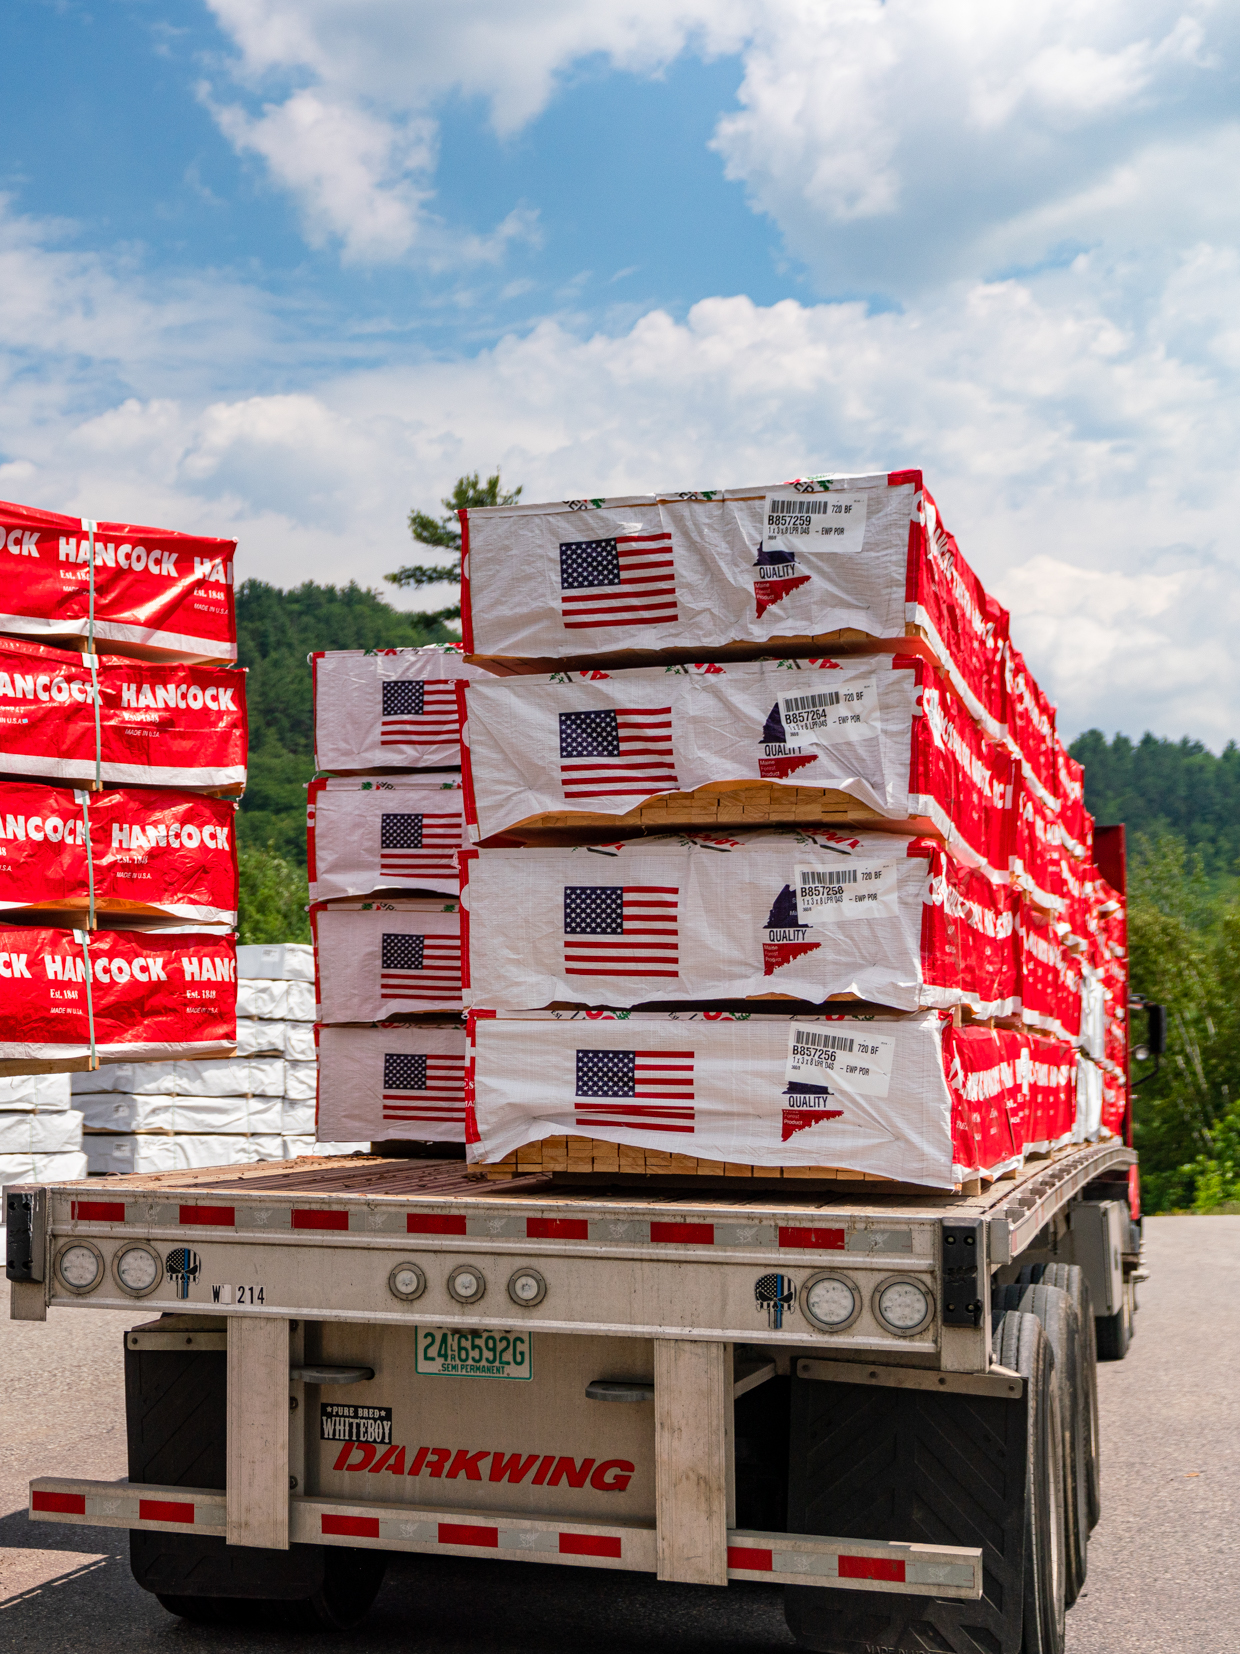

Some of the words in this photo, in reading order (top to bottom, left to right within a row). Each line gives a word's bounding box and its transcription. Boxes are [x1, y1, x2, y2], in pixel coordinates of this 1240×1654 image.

[831, 505, 842, 513] 720
[844, 505, 852, 513] BF
[768, 515, 811, 526] B857259
[821, 527, 832, 535] EWP
[59, 536, 179, 577] HANCOCK
[759, 563, 796, 579] QUALITY
[121, 682, 237, 711] HANCOCK
[843, 693, 854, 702] 720
[856, 692, 863, 700] BF
[785, 709, 827, 724] B857264
[112, 823, 229, 851] HANCOCK
[861, 872, 872, 880] 720
[874, 871, 882, 879] BF
[801, 886, 843, 897] B857258
[769, 929, 806, 943] QUALITY
[44, 955, 168, 983] HANCOCK
[50, 989, 62, 998] Est.
[186, 990, 200, 998] Est.
[793, 1045, 836, 1061] B857256
[858, 1044, 869, 1053] 720
[870, 1046, 879, 1054] BF
[846, 1065, 857, 1073] EWP
[789, 1096, 827, 1108] QUALITY
[212, 1285, 220, 1303] W
[237, 1286, 264, 1304] 214
[424, 1332, 448, 1361] 24
[457, 1334, 524, 1365] 6592G
[442, 1363, 458, 1372] SEMI
[461, 1363, 504, 1374] PERMANENT
[333, 1406, 354, 1416] PURE
[358, 1408, 380, 1417] BRED
[322, 1417, 391, 1443] WHITEBOY
[333, 1442, 635, 1491] DARKWING
